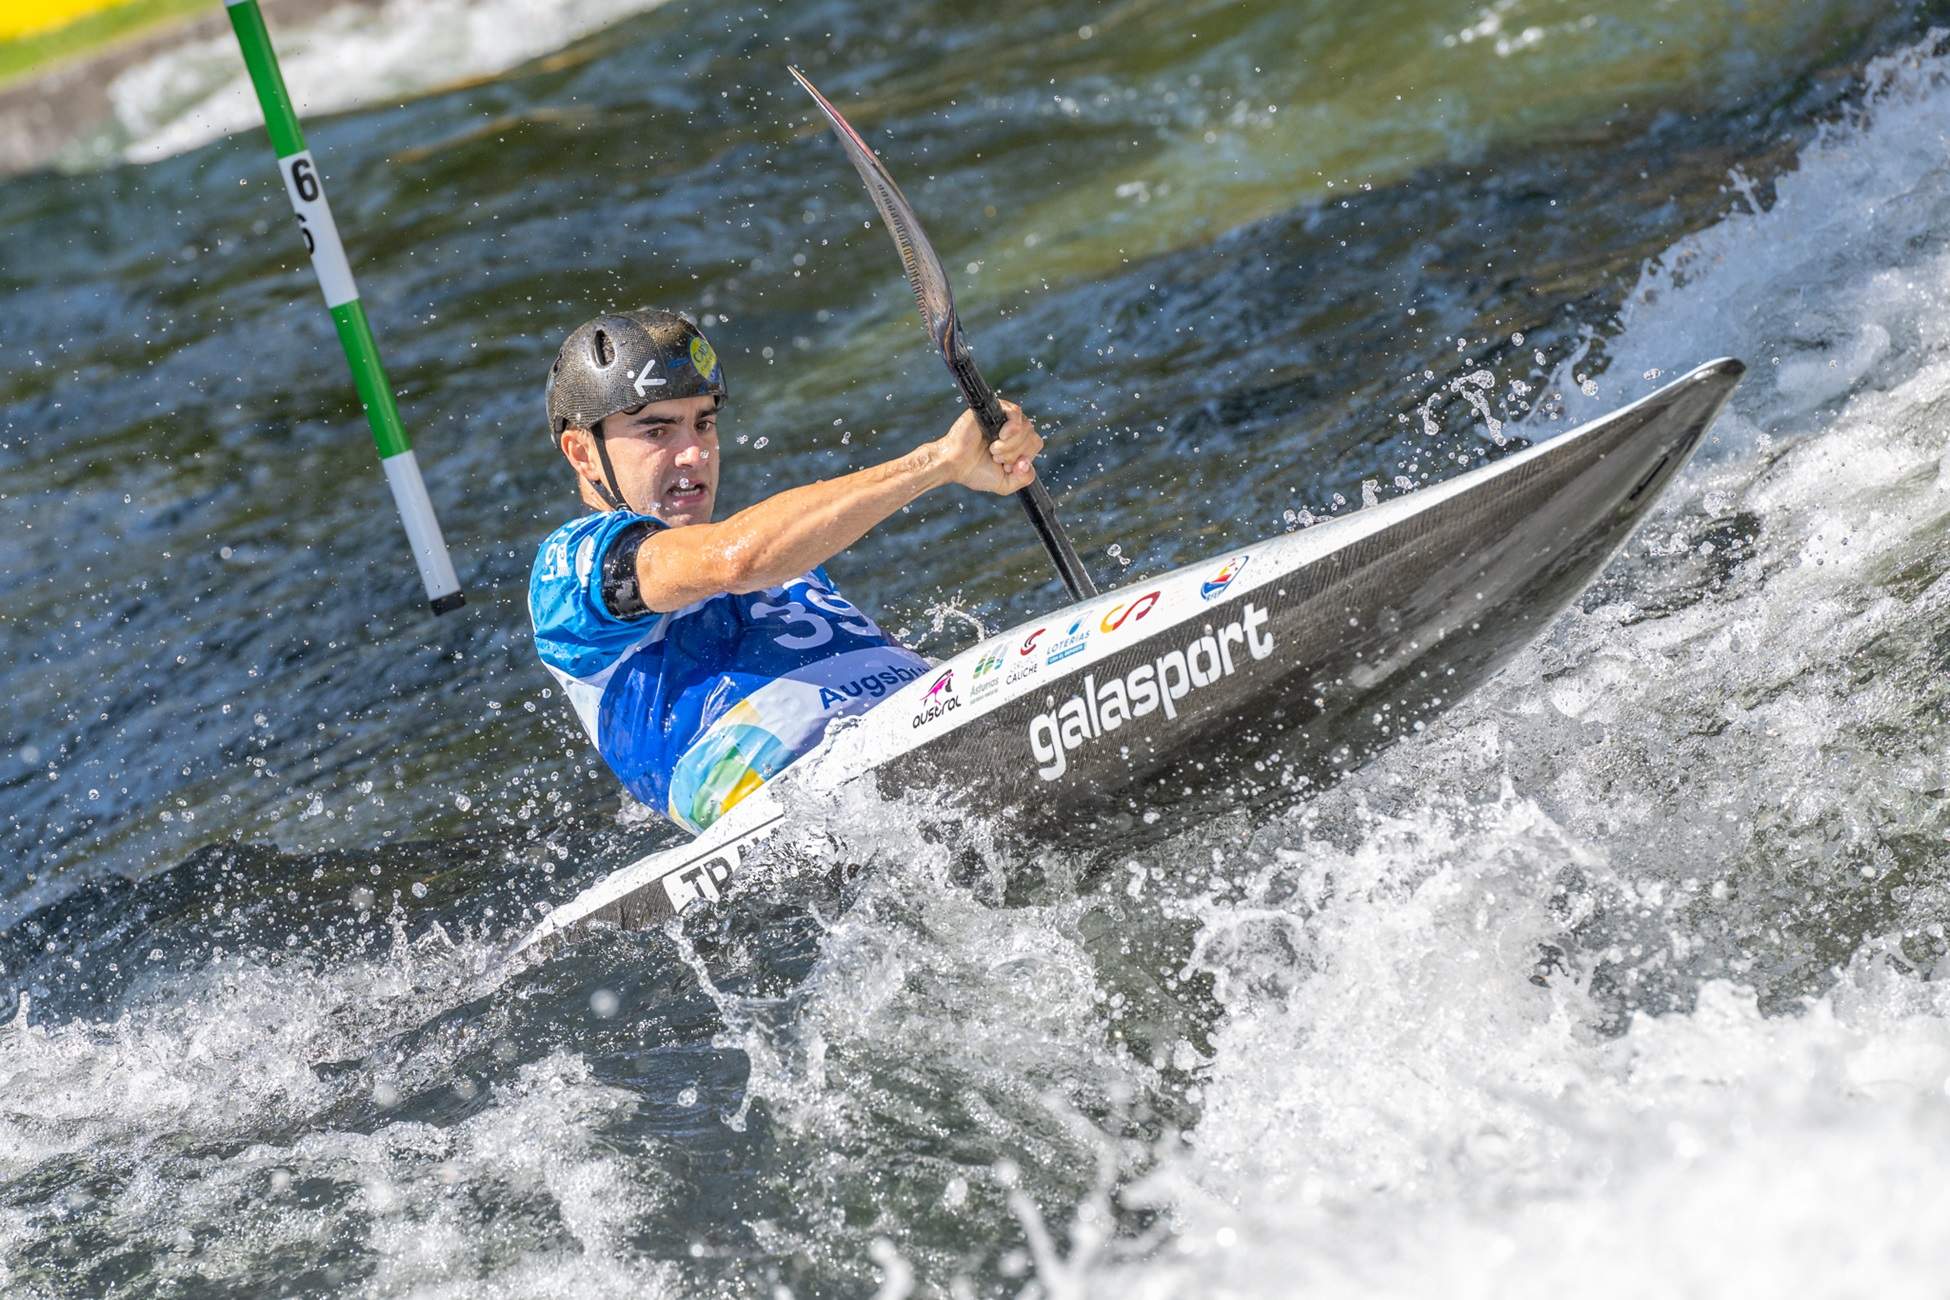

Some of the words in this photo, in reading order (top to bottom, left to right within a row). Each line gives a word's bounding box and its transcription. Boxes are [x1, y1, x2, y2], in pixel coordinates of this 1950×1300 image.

[291, 158, 319, 202] 6
[912, 695, 961, 729] austral
[1029, 602, 1274, 781] galasport
